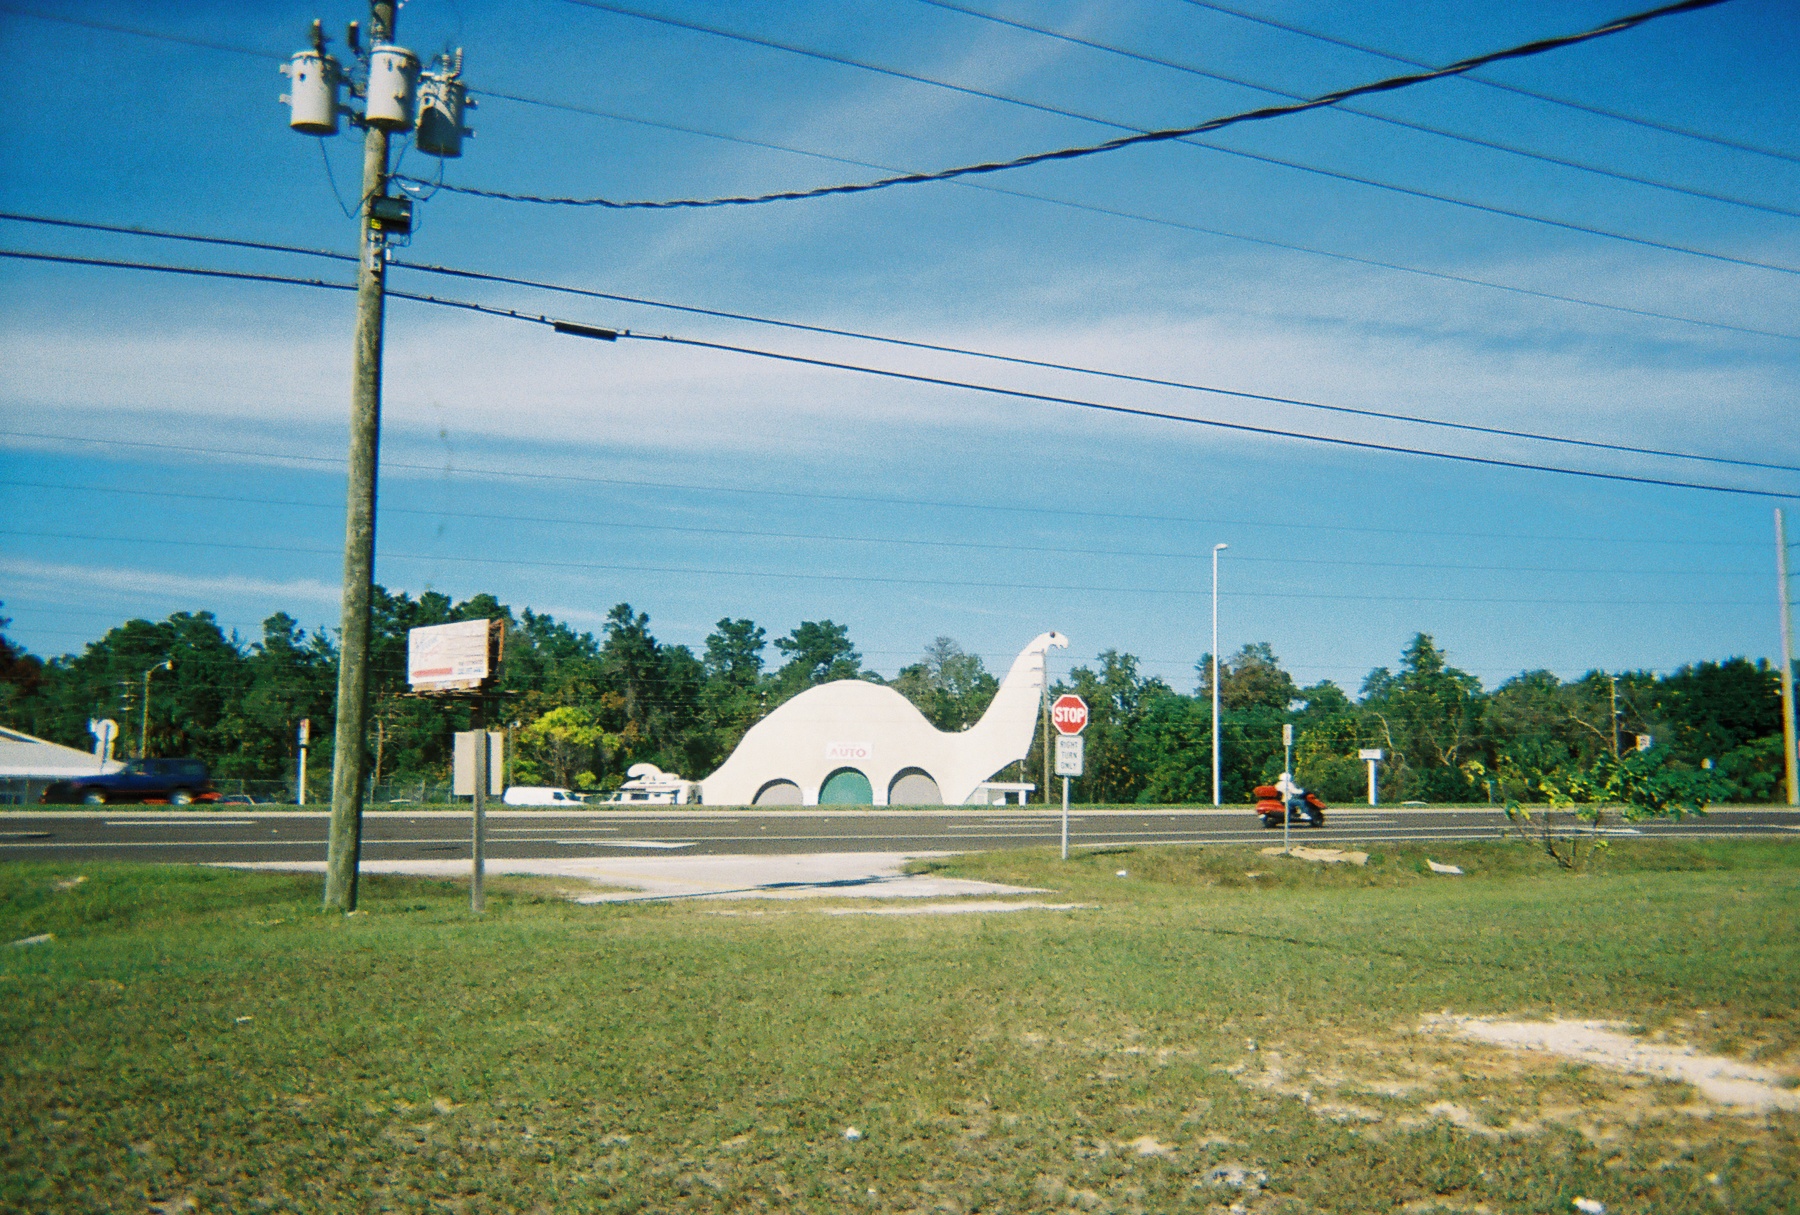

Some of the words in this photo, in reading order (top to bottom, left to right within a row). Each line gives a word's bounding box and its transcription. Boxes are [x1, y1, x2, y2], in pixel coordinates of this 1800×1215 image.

[1055, 707, 1085, 723] STOP
[1060, 741, 1078, 749] RIGHT
[831, 748, 867, 758] AUTO
[1061, 751, 1078, 759] TURN
[1061, 762, 1076, 770] ONLY
